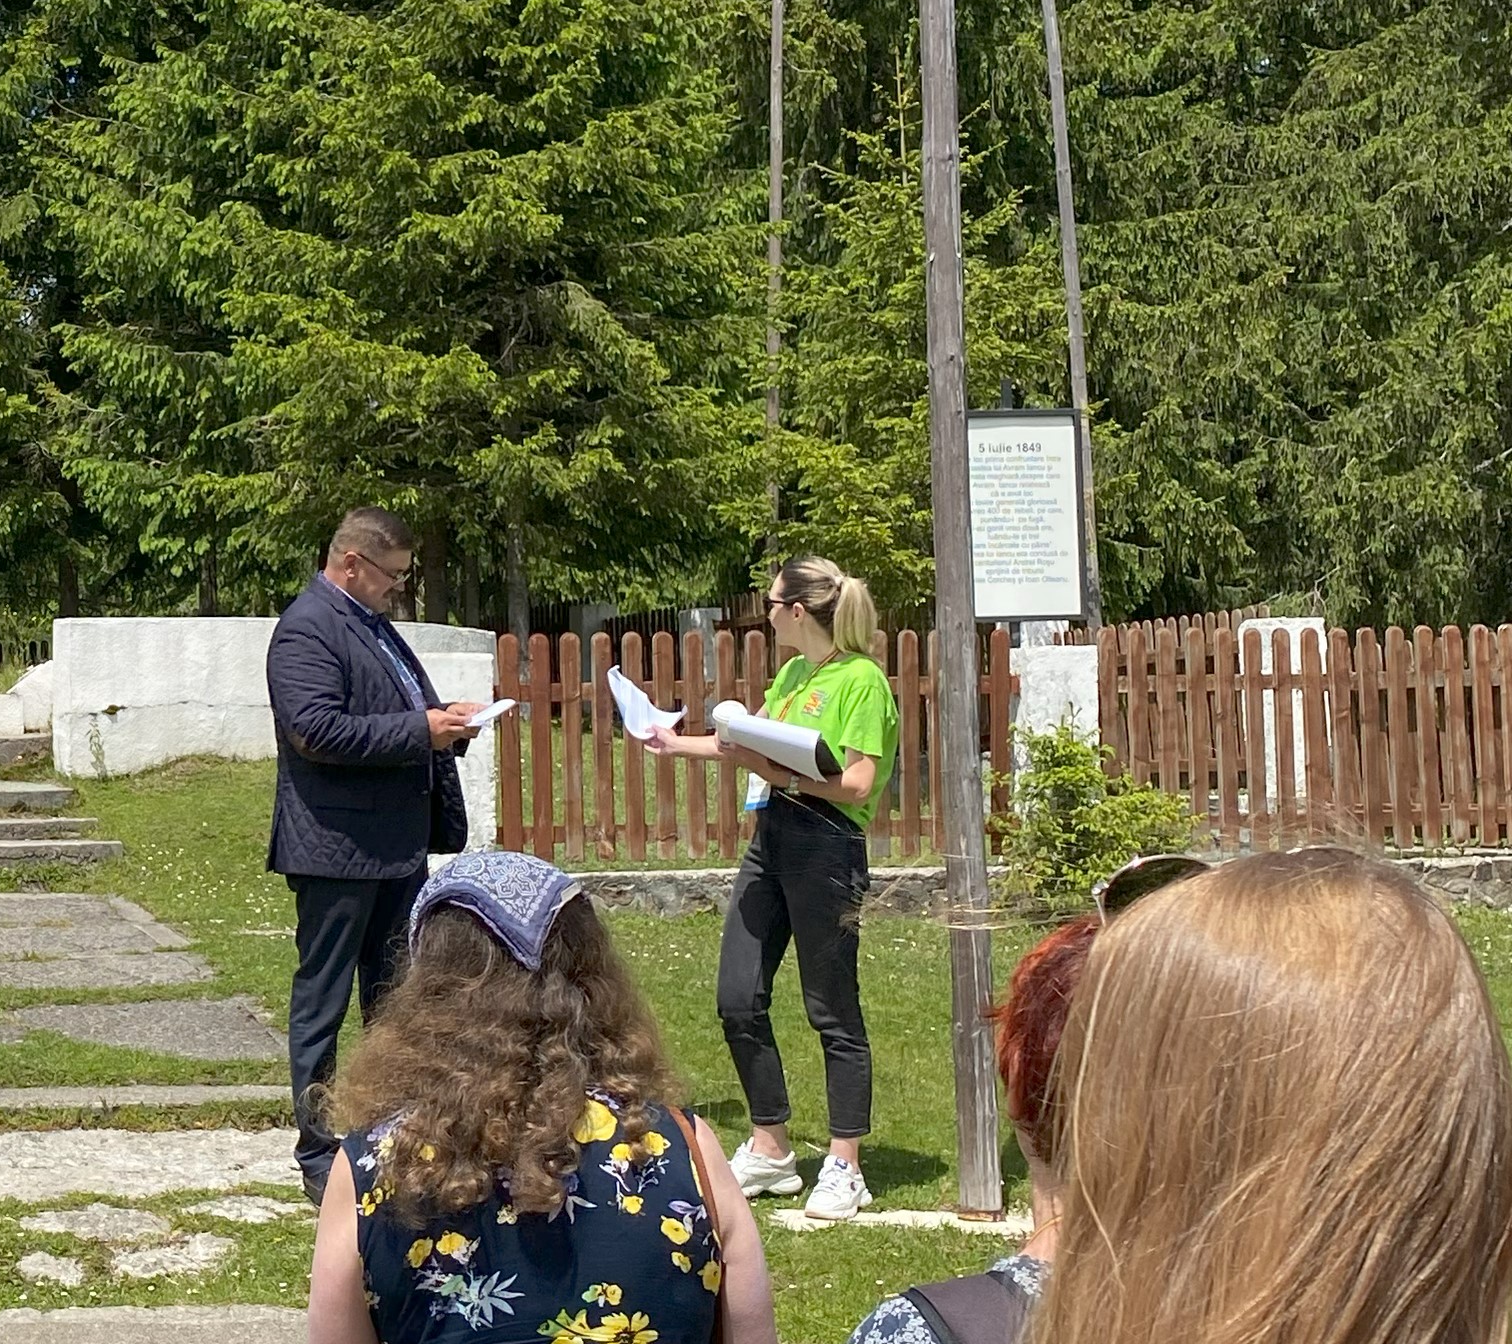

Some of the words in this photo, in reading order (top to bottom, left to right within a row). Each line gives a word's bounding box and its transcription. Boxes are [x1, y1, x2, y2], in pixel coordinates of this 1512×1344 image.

[979, 443, 985, 453] 5
[988, 443, 1012, 453] Iulie
[1017, 443, 1042, 453] 1849
